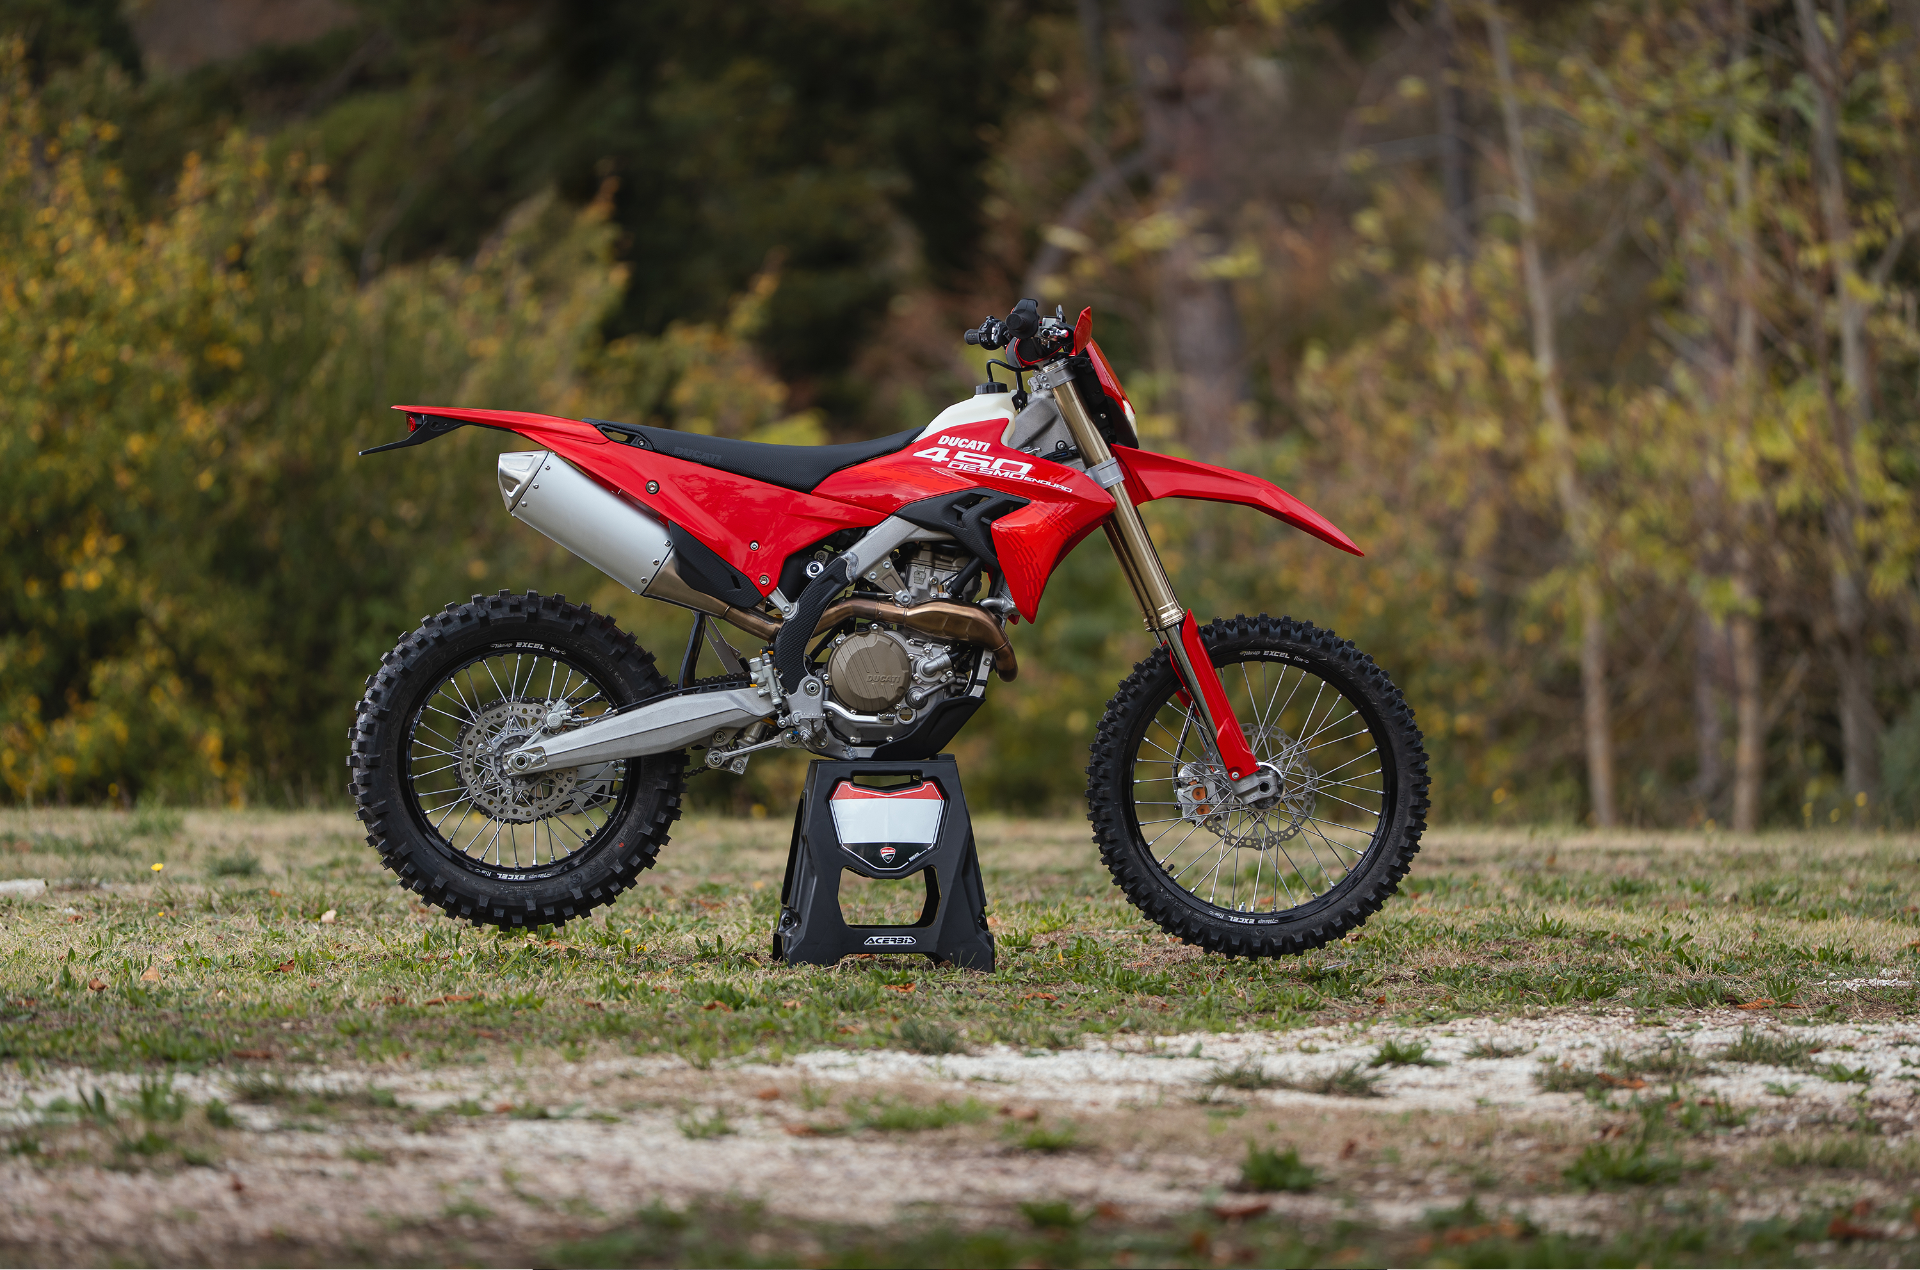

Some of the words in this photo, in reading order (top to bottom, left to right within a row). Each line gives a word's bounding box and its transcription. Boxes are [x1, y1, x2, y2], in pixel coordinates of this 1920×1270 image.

[937, 435, 991, 453] DUCATI
[673, 446, 722, 463] DUCATI
[912, 446, 1033, 476] 450
[515, 641, 545, 650] EXCEL
[1263, 650, 1290, 659] EXCEL
[866, 674, 901, 684] DUCATI
[496, 872, 526, 880] EXCEL
[1228, 915, 1256, 924] EXCEL
[864, 936, 917, 945] ACERBIS
